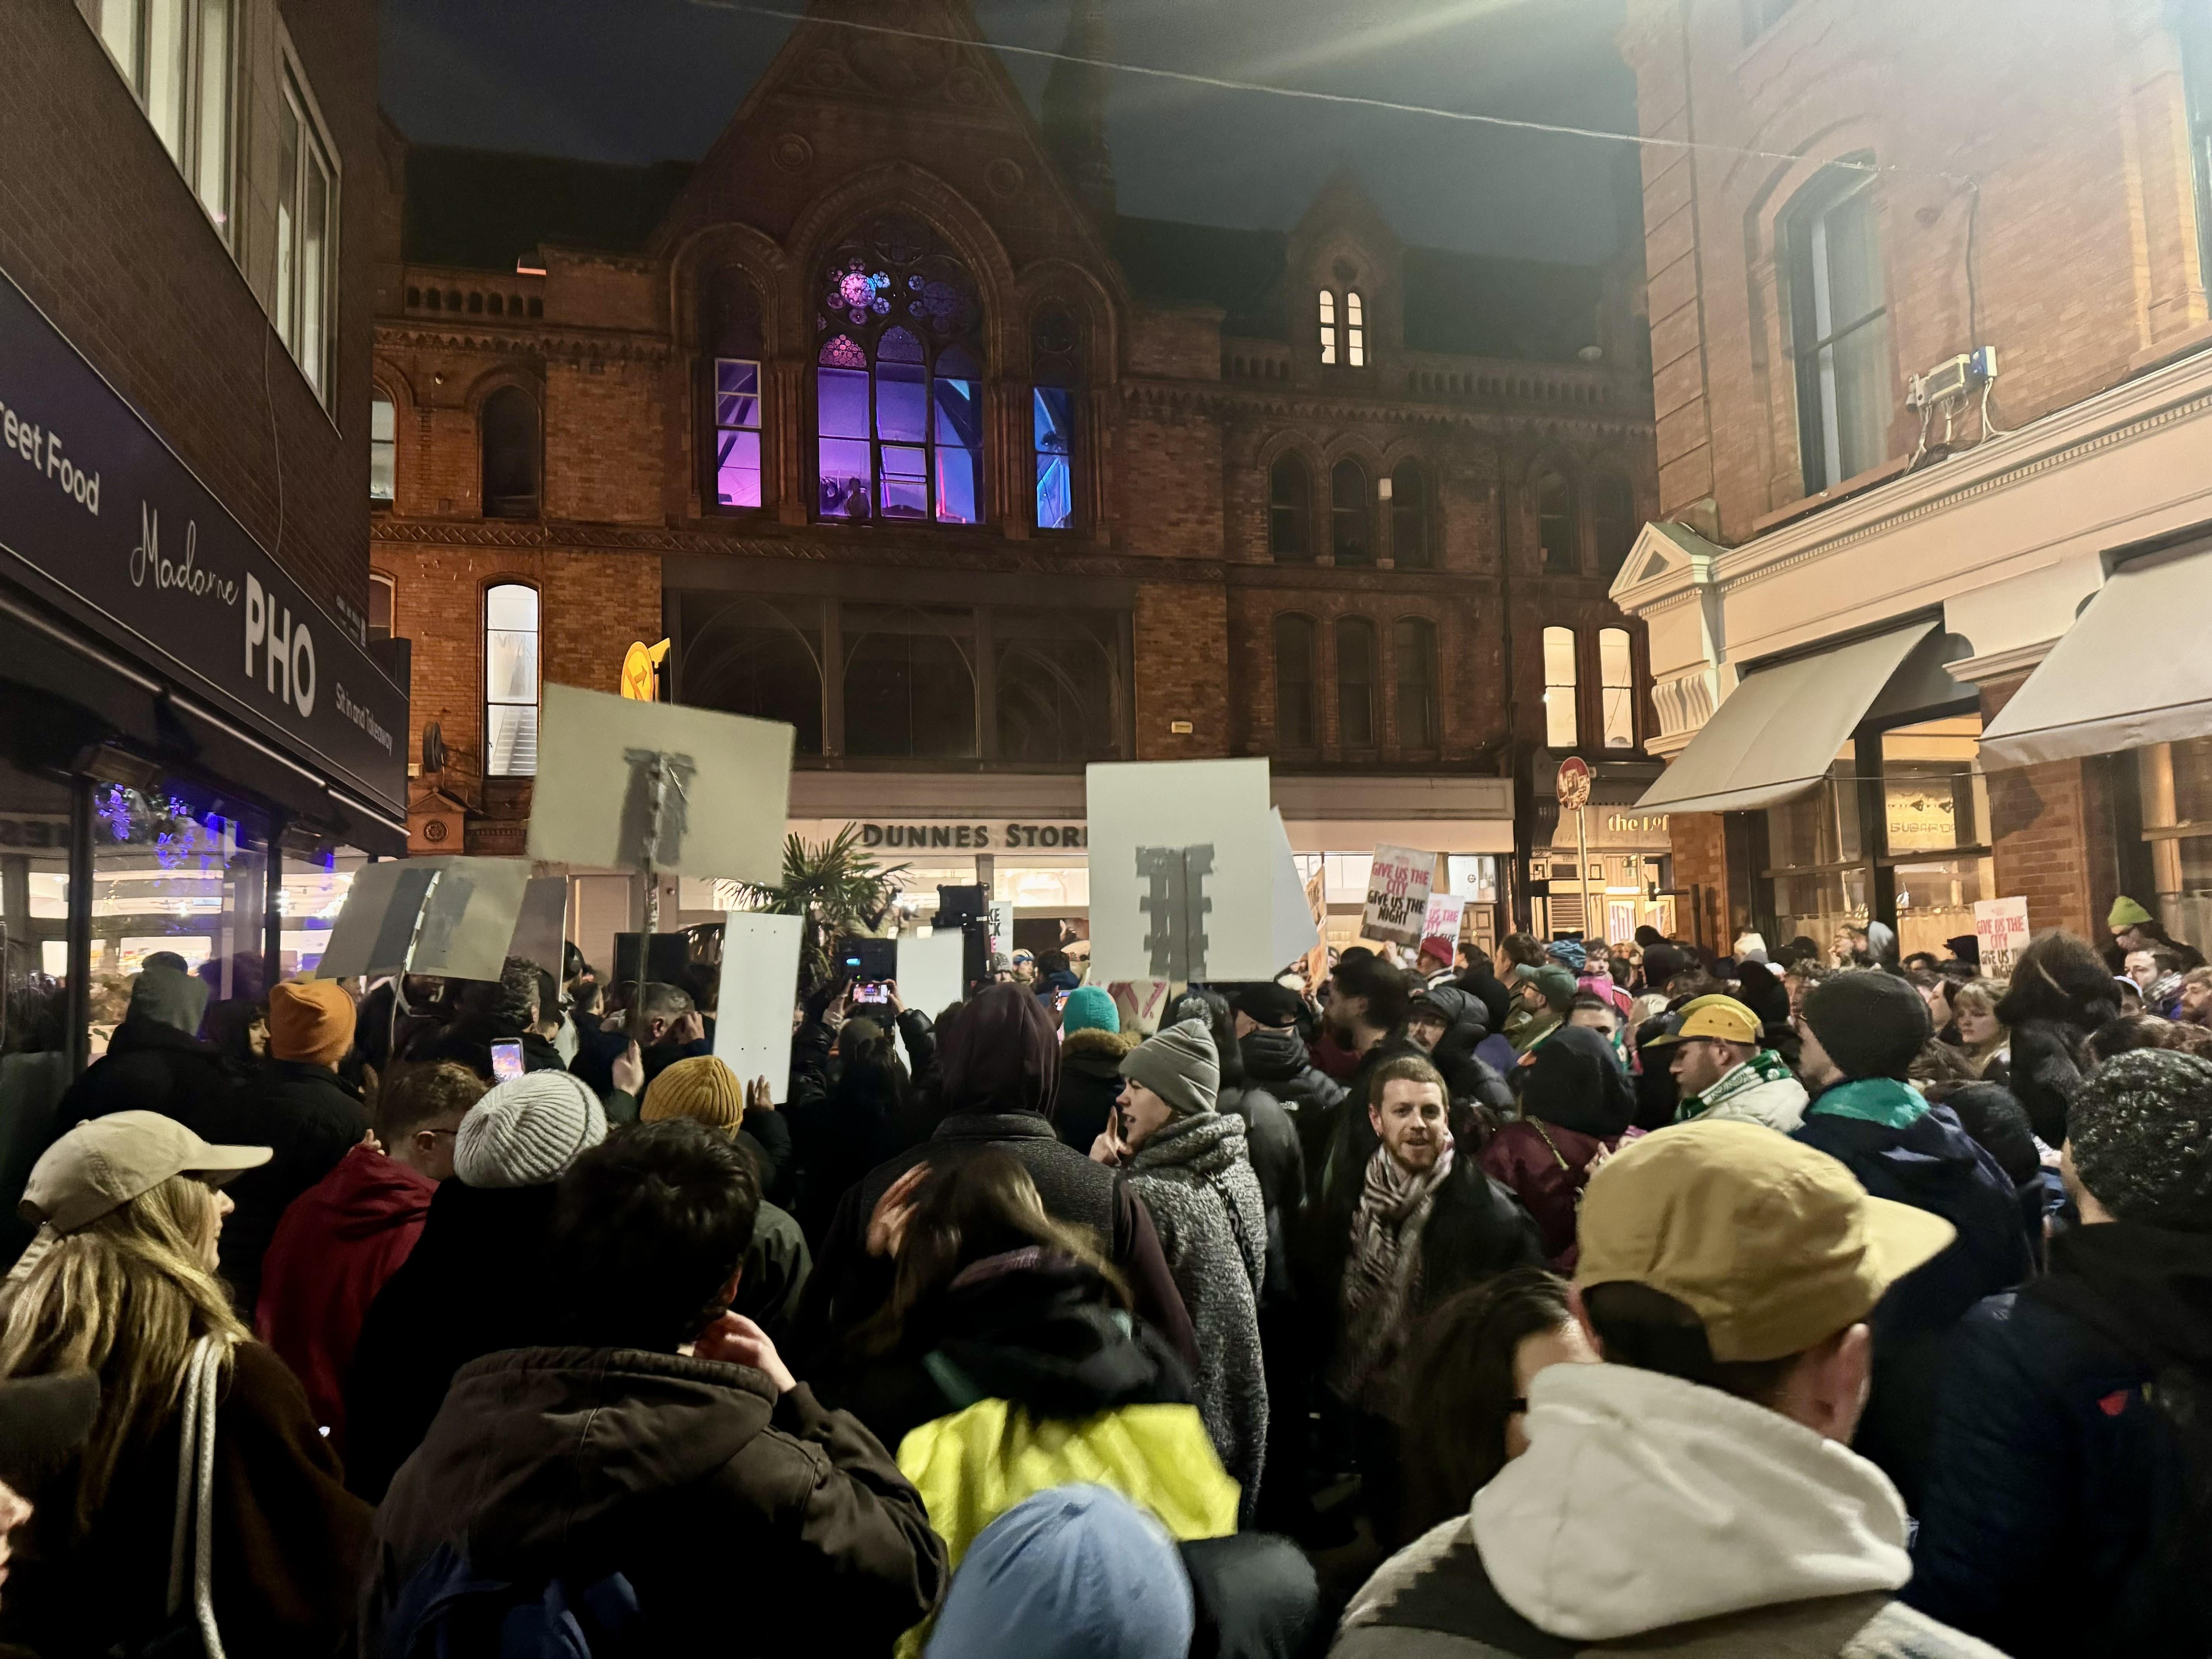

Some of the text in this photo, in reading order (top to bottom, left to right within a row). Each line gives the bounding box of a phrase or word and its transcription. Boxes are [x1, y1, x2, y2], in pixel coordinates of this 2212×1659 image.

[47, 431, 99, 516] Food
[246, 571, 316, 717] PHO
[1608, 814, 1638, 831] the
[863, 823, 1087, 847] DUNNES STOR
[1372, 861, 1429, 886] GIVE US THE
[1387, 879, 1408, 899] CITY
[1368, 890, 1425, 914] GIVE US THE
[1377, 906, 1408, 926] NIGHT
[1443, 909, 1459, 922] THE
[1977, 915, 2025, 935] GIVE US THE
[1991, 933, 2008, 949] CITY
[1997, 950, 2009, 963] US
